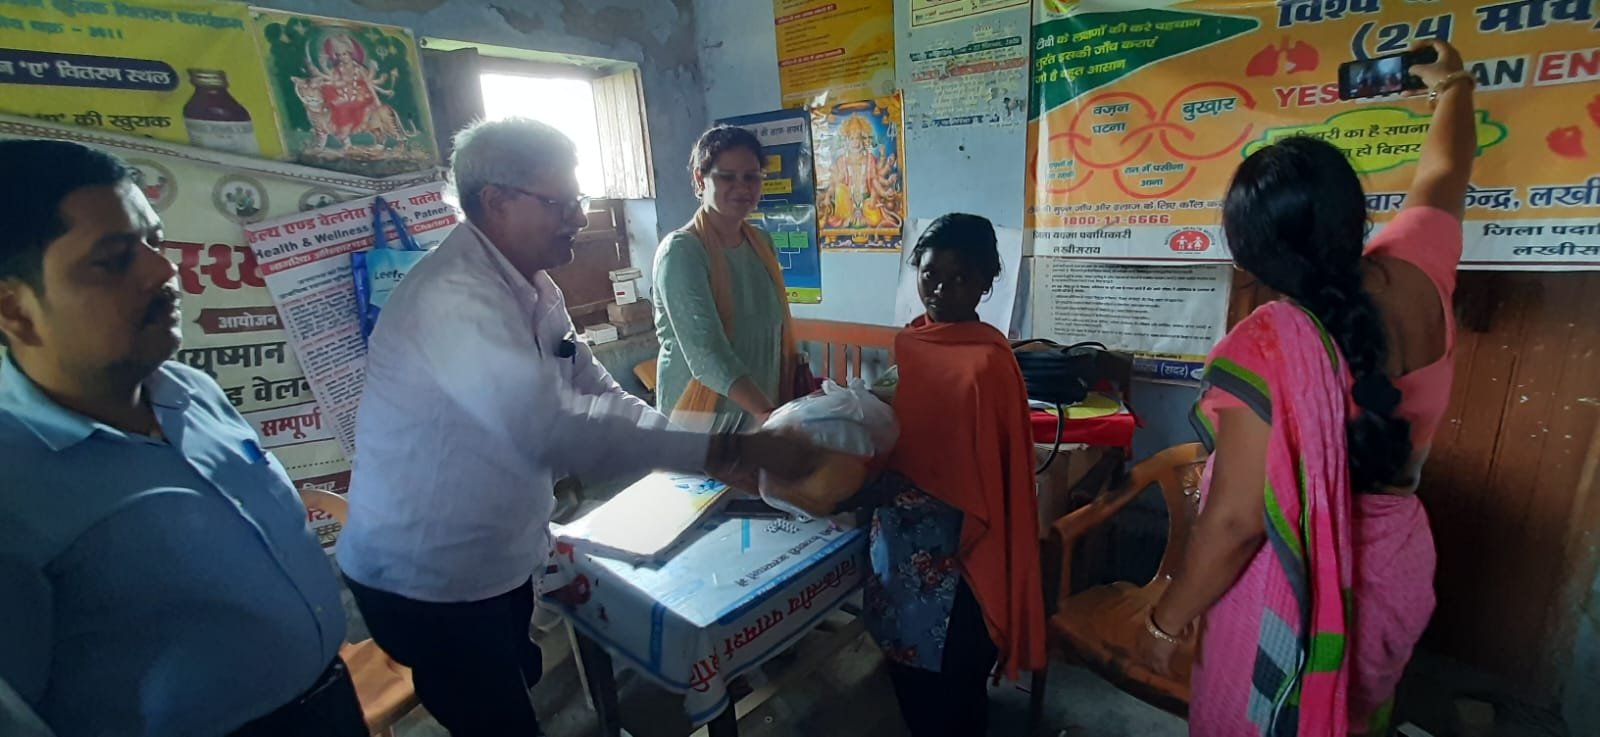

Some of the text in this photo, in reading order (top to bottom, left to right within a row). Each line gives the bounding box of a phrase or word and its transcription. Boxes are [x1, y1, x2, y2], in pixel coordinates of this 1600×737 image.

[55, 61, 121, 82] वितरण
[125, 68, 170, 84] स्थल
[1471, 57, 1525, 86] AN
[72, 110, 102, 127] की
[108, 115, 171, 130] खुराक
[1344, 128, 1364, 138] का
[1368, 124, 1380, 138] है
[1377, 143, 1422, 156] बिहार
[1156, 200, 1176, 210] लिए
[1063, 214, 1170, 226] 1800-11-6666
[1484, 222, 1542, 236] जिला
[302, 237, 313, 248] &
[314, 223, 370, 246] Wellness
[218, 311, 278, 330] आयोजन
[260, 407, 322, 440] सम्पूर्ण
